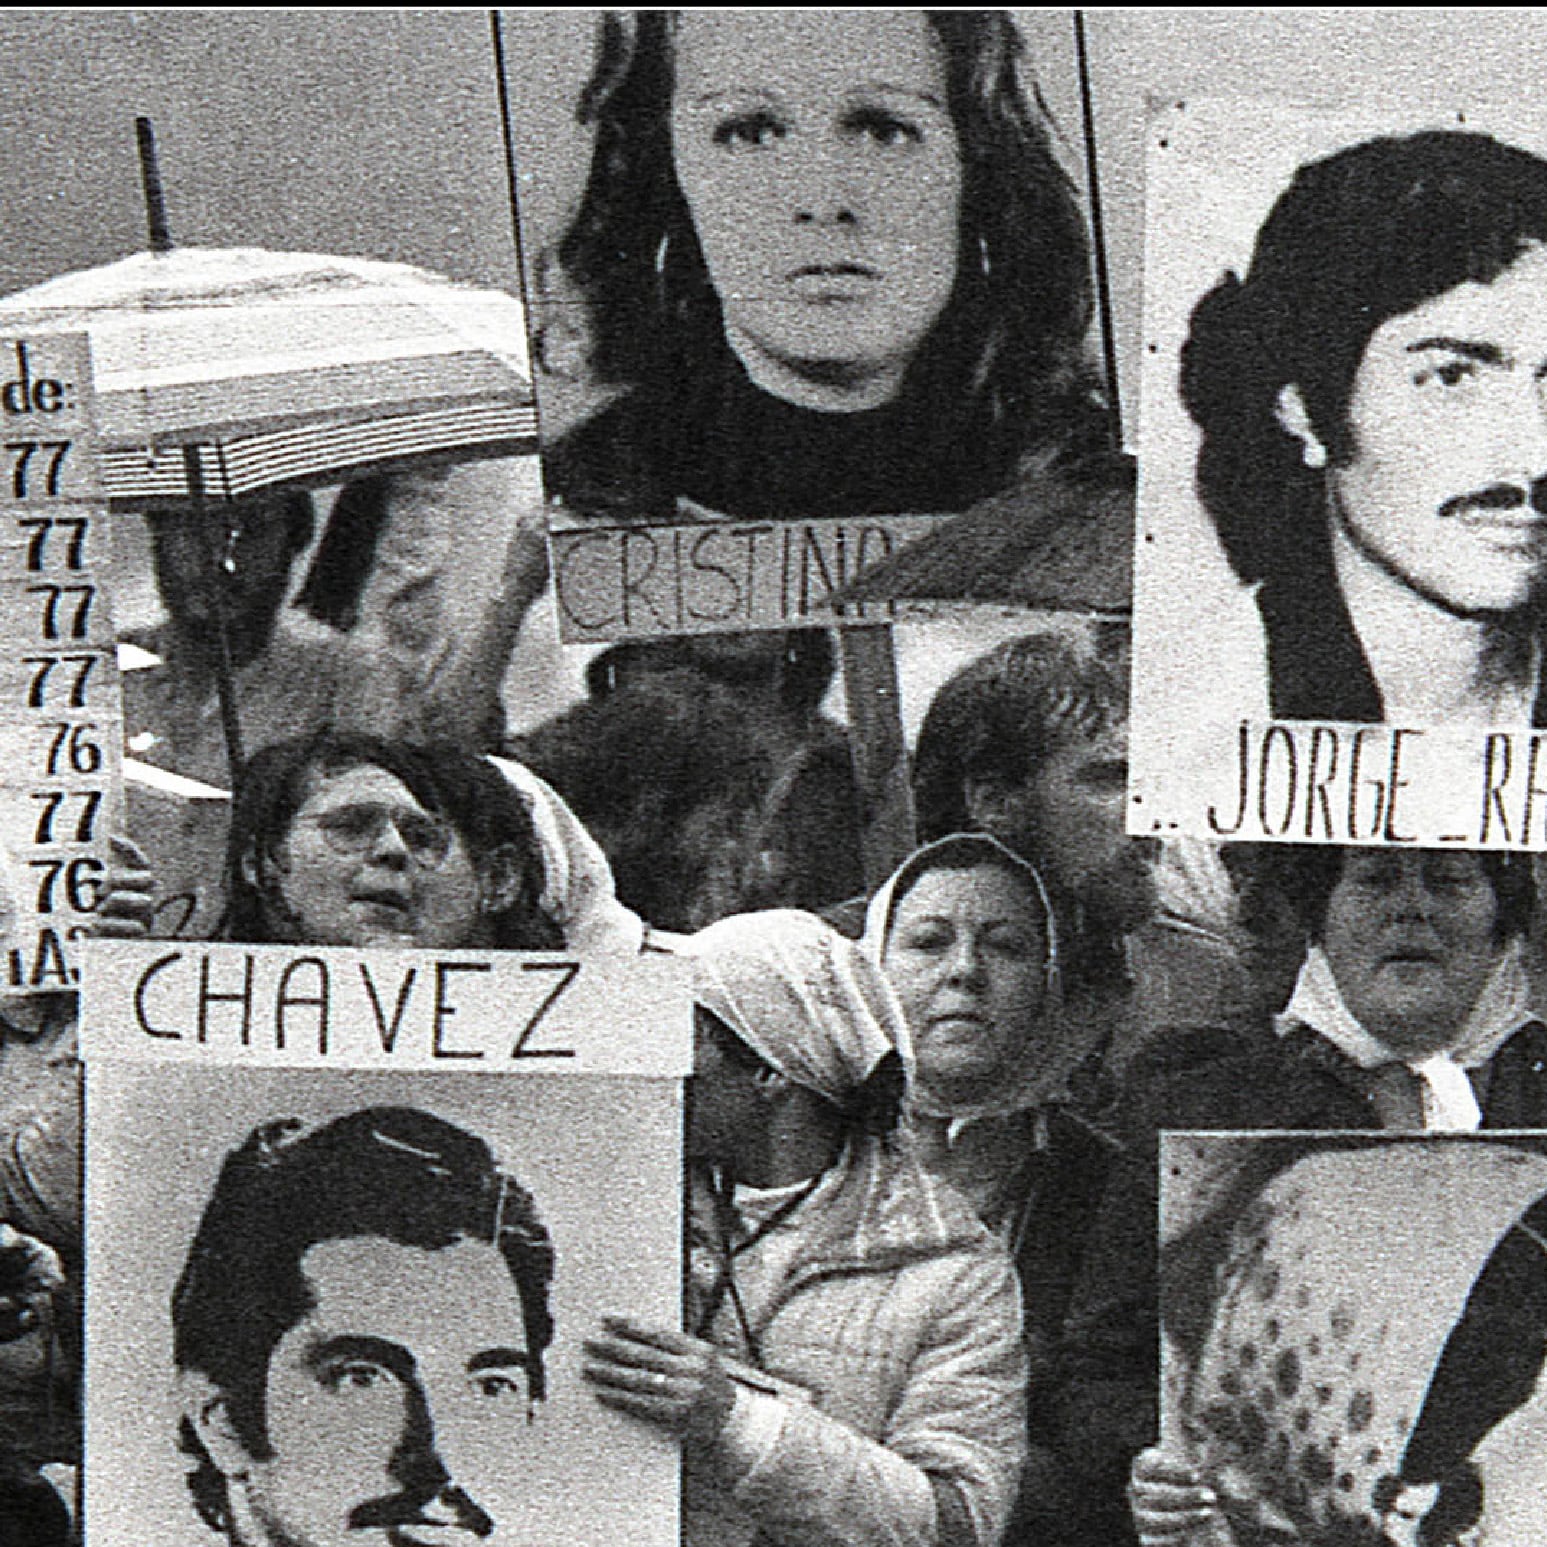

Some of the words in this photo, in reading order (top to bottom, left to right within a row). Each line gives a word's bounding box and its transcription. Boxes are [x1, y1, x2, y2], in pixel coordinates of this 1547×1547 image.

[1, 340, 73, 414] de:
[2, 440, 72, 498] 77
[18, 518, 88, 570] 77
[25, 585, 95, 639] 77
[22, 655, 97, 708] 77
[39, 722, 102, 776] 76
[1207, 719, 1425, 843] JORGE
[30, 791, 102, 844] 77
[28, 857, 105, 914] 76
[134, 952, 581, 1059] CHAVEZ
